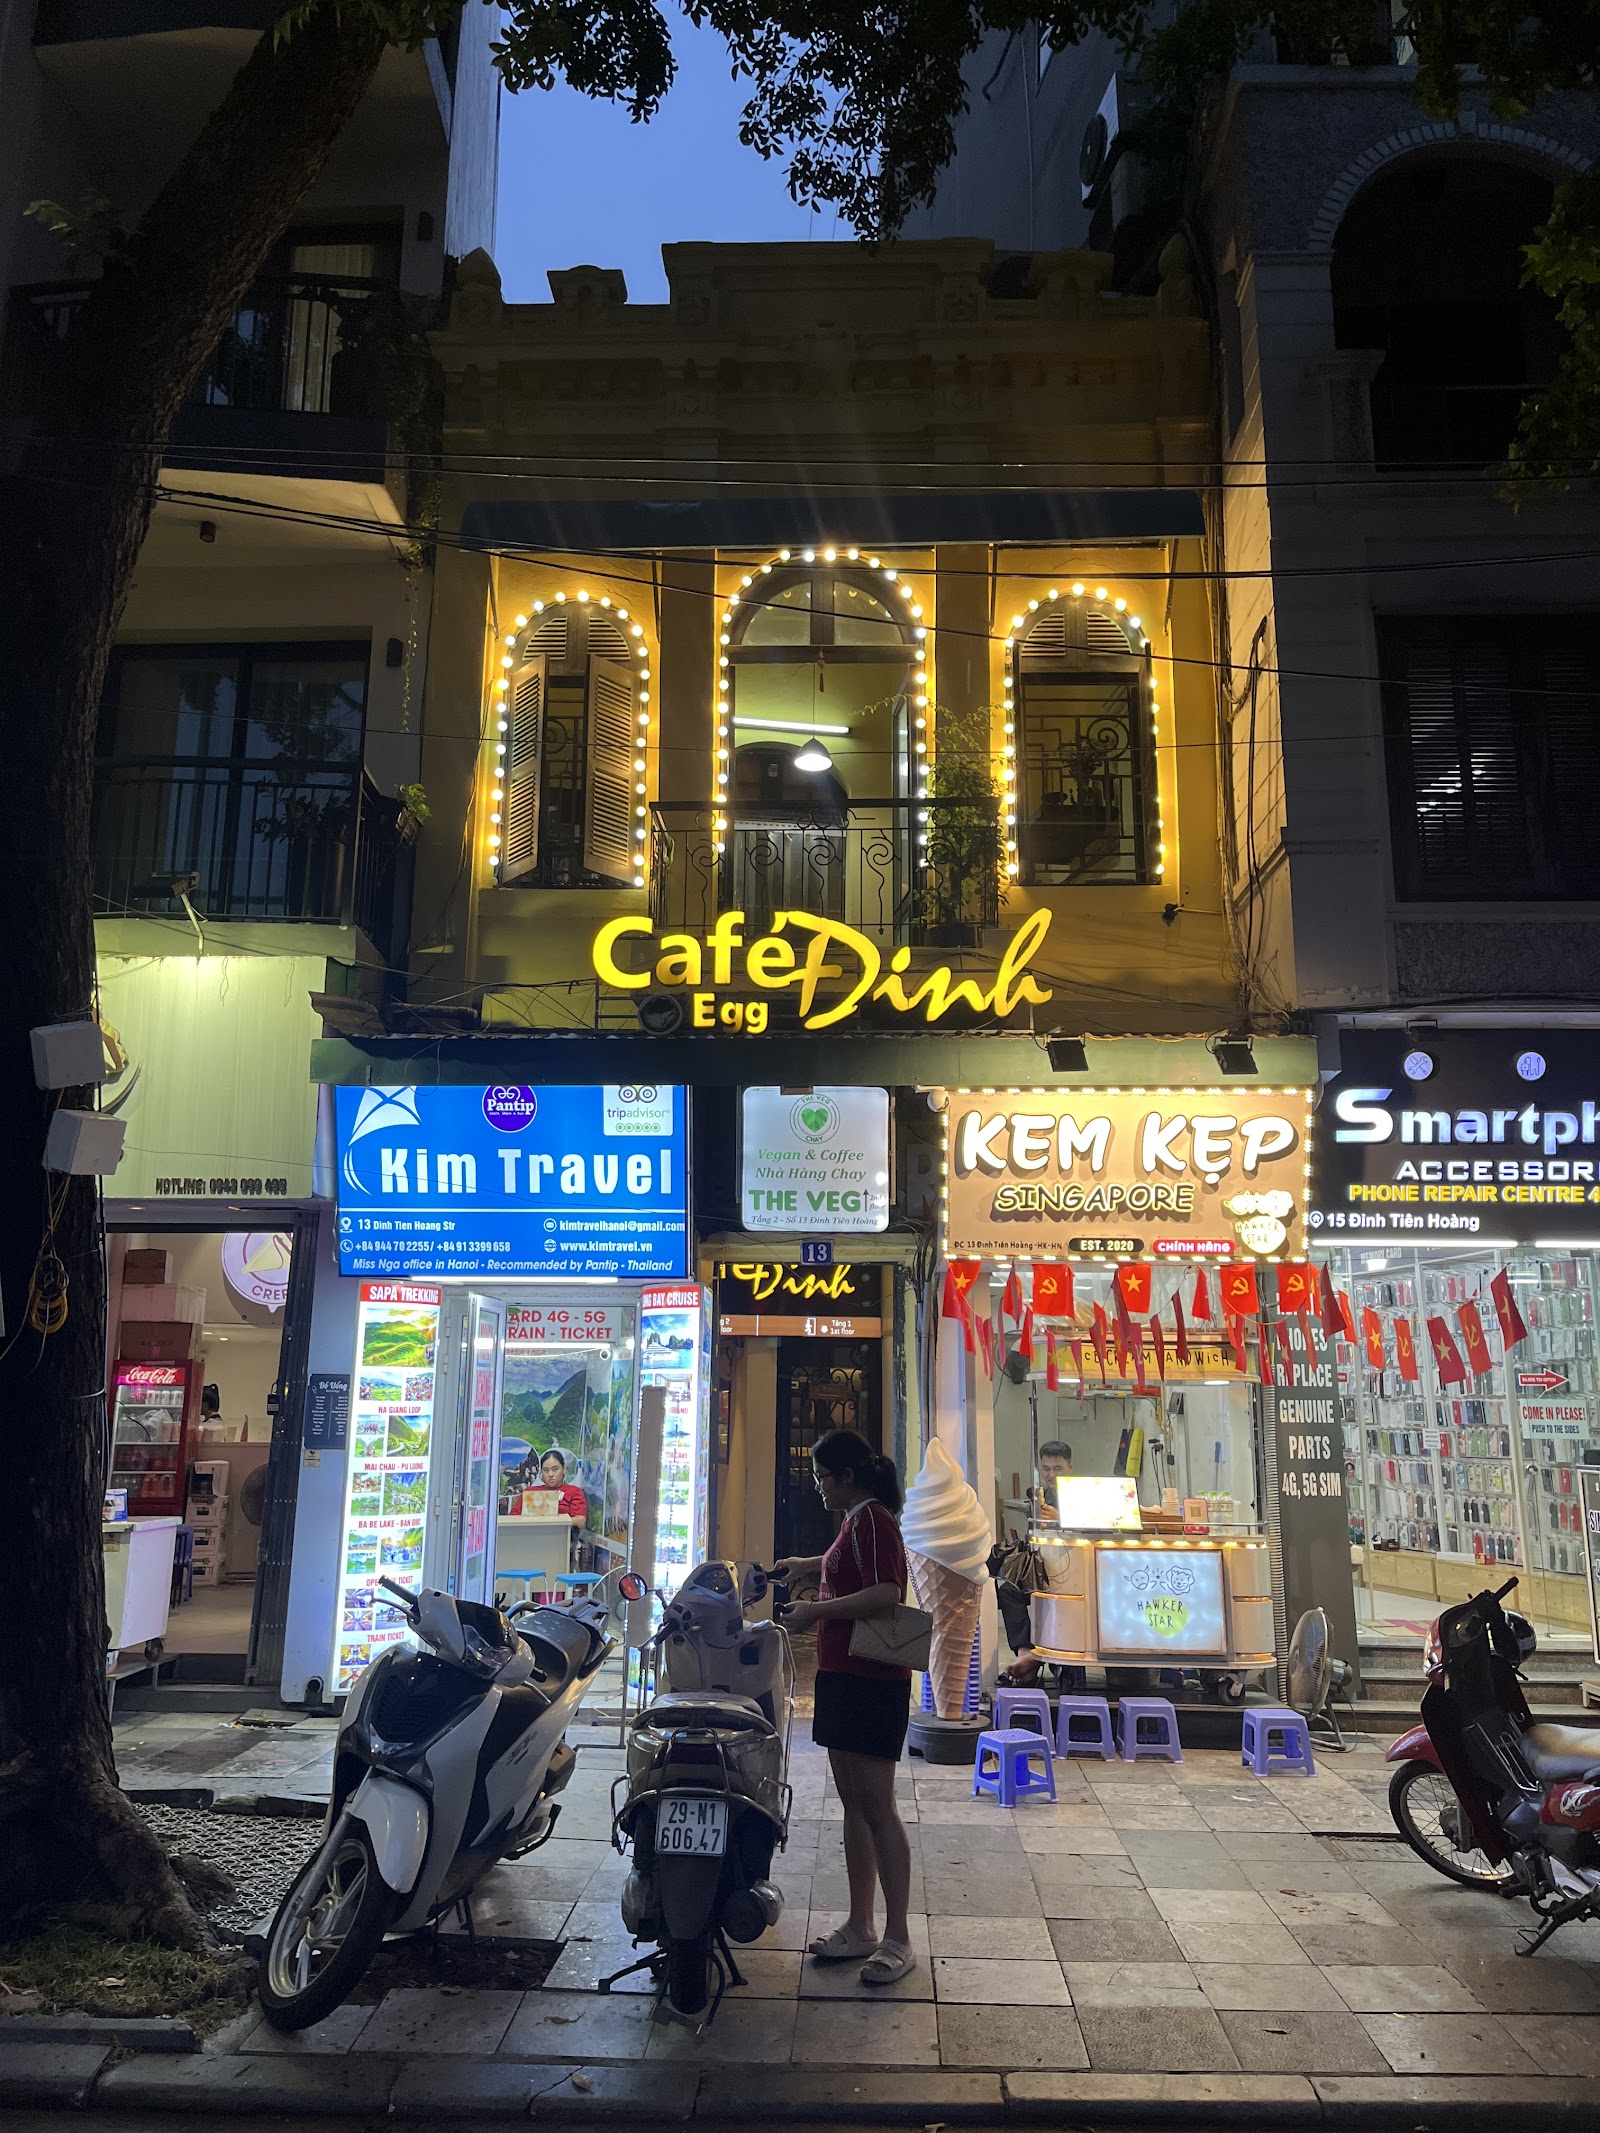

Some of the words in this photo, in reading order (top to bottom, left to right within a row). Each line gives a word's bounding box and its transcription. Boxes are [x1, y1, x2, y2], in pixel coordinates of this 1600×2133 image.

[592, 910, 796, 989] Café
[693, 993, 769, 1034] Egg
[487, 1099, 534, 1115] Pantip
[607, 1107, 665, 1120] tripadvisor
[805, 1135, 824, 1143] CHAY
[962, 1110, 1113, 1172] KEM
[1141, 1110, 1296, 1186] KẸP
[758, 1149, 800, 1163] Vegan
[805, 1150, 816, 1160] &
[820, 1149, 864, 1163] Coffee
[381, 1148, 477, 1194] Kim
[498, 1148, 672, 1195] Travel
[755, 1167, 784, 1178] Nhà
[788, 1167, 827, 1181] Hàng
[831, 1168, 867, 1182] Chay
[748, 1189, 798, 1211] THE
[995, 1182, 1195, 1213] SINGAPORE
[1350, 1184, 1419, 1202] PHONE
[1424, 1184, 1498, 1202] REPAIR
[1502, 1185, 1585, 1203] CENTRE
[358, 1219, 371, 1230] 13
[373, 1221, 392, 1230] Dinh
[414, 1221, 441, 1231] Hoang
[443, 1220, 456, 1230] Str
[559, 1220, 685, 1233] kimtravelhanoi@gmail.com
[1235, 1221, 1280, 1233] HAWKER
[1327, 1213, 1345, 1228] 15
[1349, 1213, 1386, 1228] Đinh
[1389, 1213, 1424, 1228] Tiên
[1427, 1213, 1480, 1232] Hoàng
[1081, 1240, 1105, 1251] EST.
[1107, 1240, 1134, 1251] 2020
[1247, 1233, 1270, 1244] STAR
[560, 1241, 653, 1252] www.kimtravel.vn
[807, 1246, 828, 1262] 13
[353, 1258, 375, 1269] Miss
[378, 1259, 400, 1272] Nga
[403, 1258, 432, 1270] office
[435, 1259, 445, 1269] in
[448, 1259, 479, 1270] Hanoi
[487, 1259, 567, 1271] Recommended
[569, 1260, 583, 1272] by
[585, 1260, 618, 1272] Pantip
[627, 1260, 673, 1271] Thailand
[370, 1286, 398, 1301] SAPA
[400, 1287, 439, 1304] TREKKING
[653, 1292, 666, 1306] BAY
[666, 1291, 699, 1306] CRUISE
[547, 1311, 570, 1323] 4G
[584, 1311, 606, 1323] 5G
[560, 1327, 612, 1339] TICKET
[1276, 1363, 1333, 1388] RPLACE
[378, 1406, 387, 1414] HA
[389, 1406, 407, 1414] GIANG
[1279, 1399, 1335, 1424] GENUINE
[1522, 1406, 1544, 1420] COME
[1545, 1406, 1554, 1420] IN
[1555, 1406, 1586, 1421] PLEASE!
[1531, 1424, 1546, 1434] PUSH
[1546, 1424, 1553, 1434] TO
[1554, 1424, 1564, 1434] THE
[1564, 1424, 1580, 1434] SIDES
[1288, 1435, 1331, 1460] PARTS
[1281, 1471, 1301, 1499] 4G,
[1302, 1471, 1318, 1497] 5G
[1319, 1472, 1342, 1497] SIM
[358, 1520, 368, 1528] BA
[369, 1520, 378, 1528] BE
[380, 1520, 395, 1528] LAKE
[366, 1579, 380, 1587] OPE
[1137, 1599, 1183, 1614] HAWKER
[1149, 1613, 1173, 1628] STAR
[367, 1633, 385, 1643] TRAIN
[387, 1631, 405, 1641] TICKET
[668, 1801, 717, 1826] 29-N1
[660, 1827, 721, 1852] 606.47
